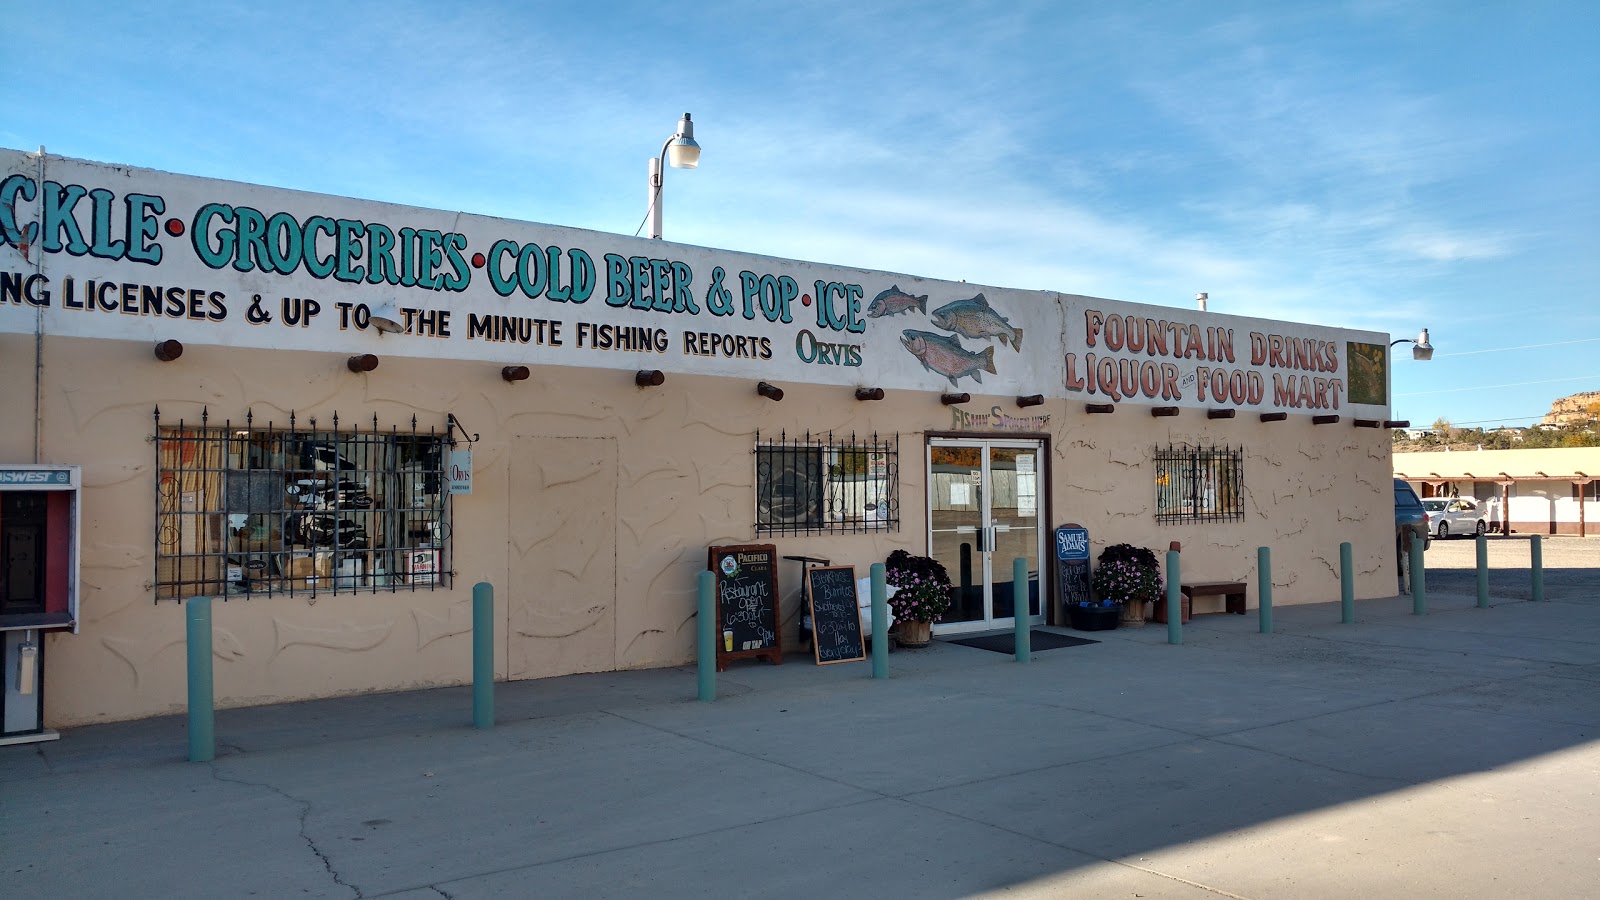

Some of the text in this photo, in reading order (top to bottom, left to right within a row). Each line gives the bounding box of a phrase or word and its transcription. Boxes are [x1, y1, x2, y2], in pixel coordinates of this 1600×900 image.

[0, 174, 866, 334] CKLE GROCERIES COLD BEER & POP ICE
[63, 278, 227, 323] LICENSES
[247, 294, 272, 325] &
[281, 298, 321, 329] UP
[337, 302, 371, 331] TO
[402, 307, 452, 338] THE
[467, 313, 563, 347] MINUTE
[577, 322, 669, 354] FISHING
[683, 331, 773, 360] REPORTS
[1085, 308, 1338, 373] FOUNTAIN DRINKS
[796, 329, 862, 367] ORVIS
[1065, 352, 1344, 410] LIQUOR AND FOOD MART
[737, 553, 768, 563] PACIFICO
[1058, 532, 1088, 543] SAMUEL
[1061, 541, 1086, 553] ADAMS
